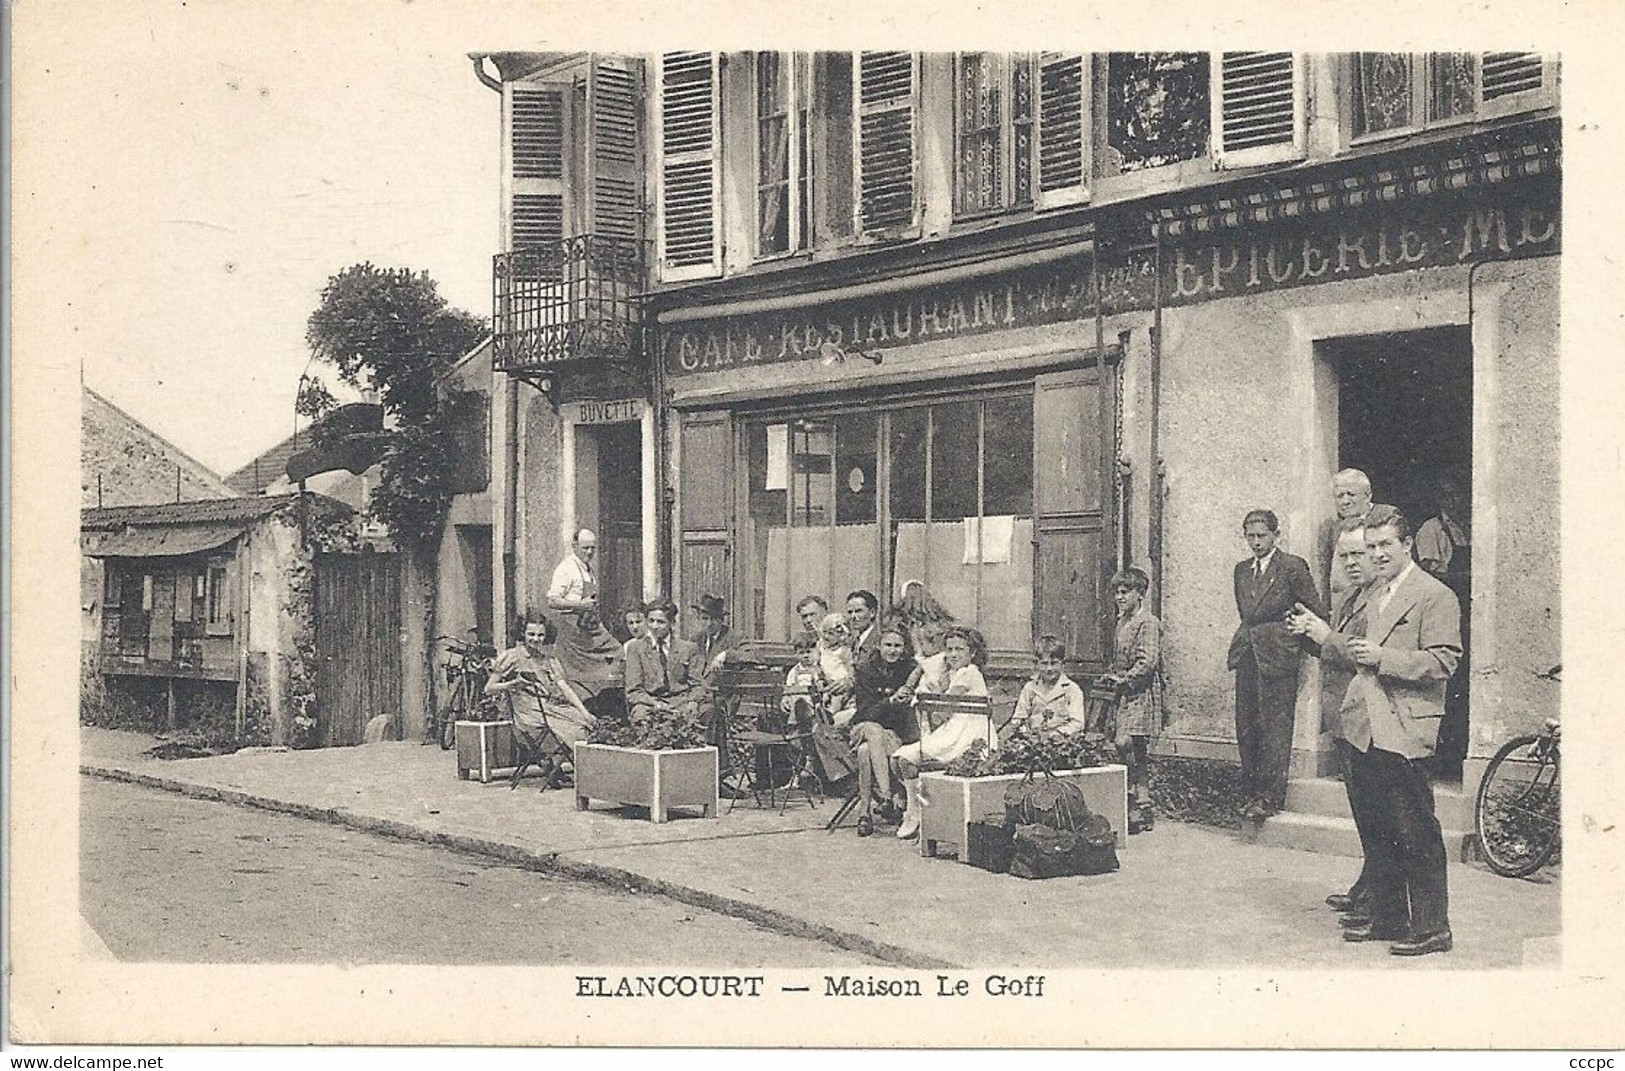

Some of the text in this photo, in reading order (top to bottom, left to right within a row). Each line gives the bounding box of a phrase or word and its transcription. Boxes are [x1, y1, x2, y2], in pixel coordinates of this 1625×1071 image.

[1170, 226, 1428, 299] EPICERIE
[777, 286, 1015, 358] RESTAURANT
[579, 400, 638, 422] BUVETTE
